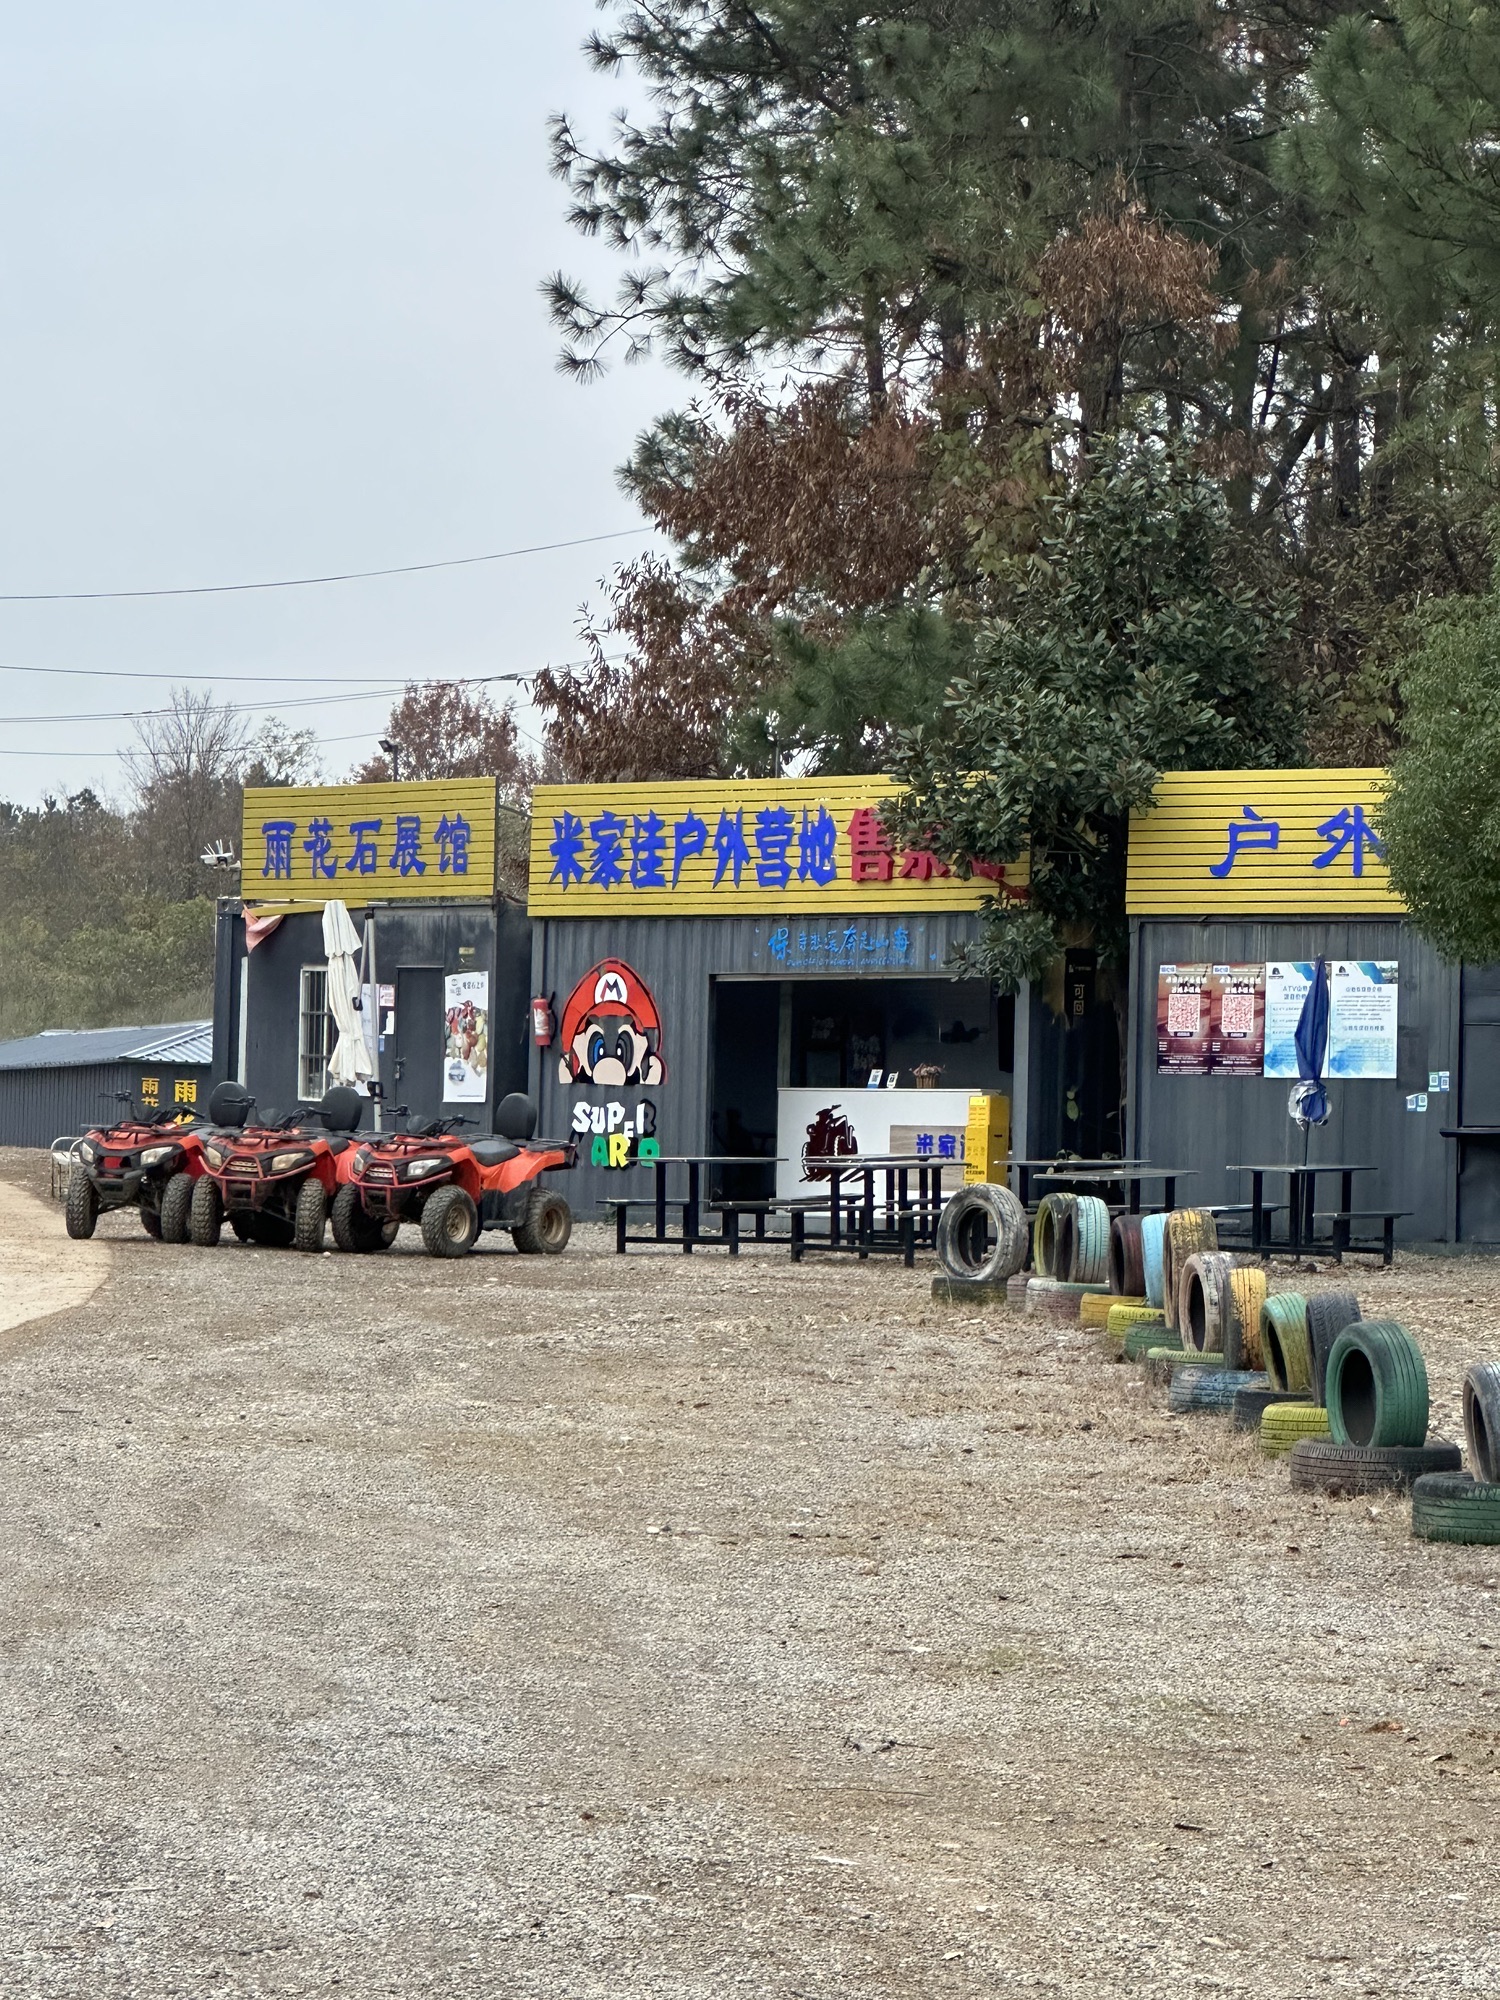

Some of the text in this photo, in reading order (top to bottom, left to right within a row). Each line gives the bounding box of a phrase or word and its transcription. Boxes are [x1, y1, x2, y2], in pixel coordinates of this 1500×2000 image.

[262, 812, 471, 880] 雨花石展馆
